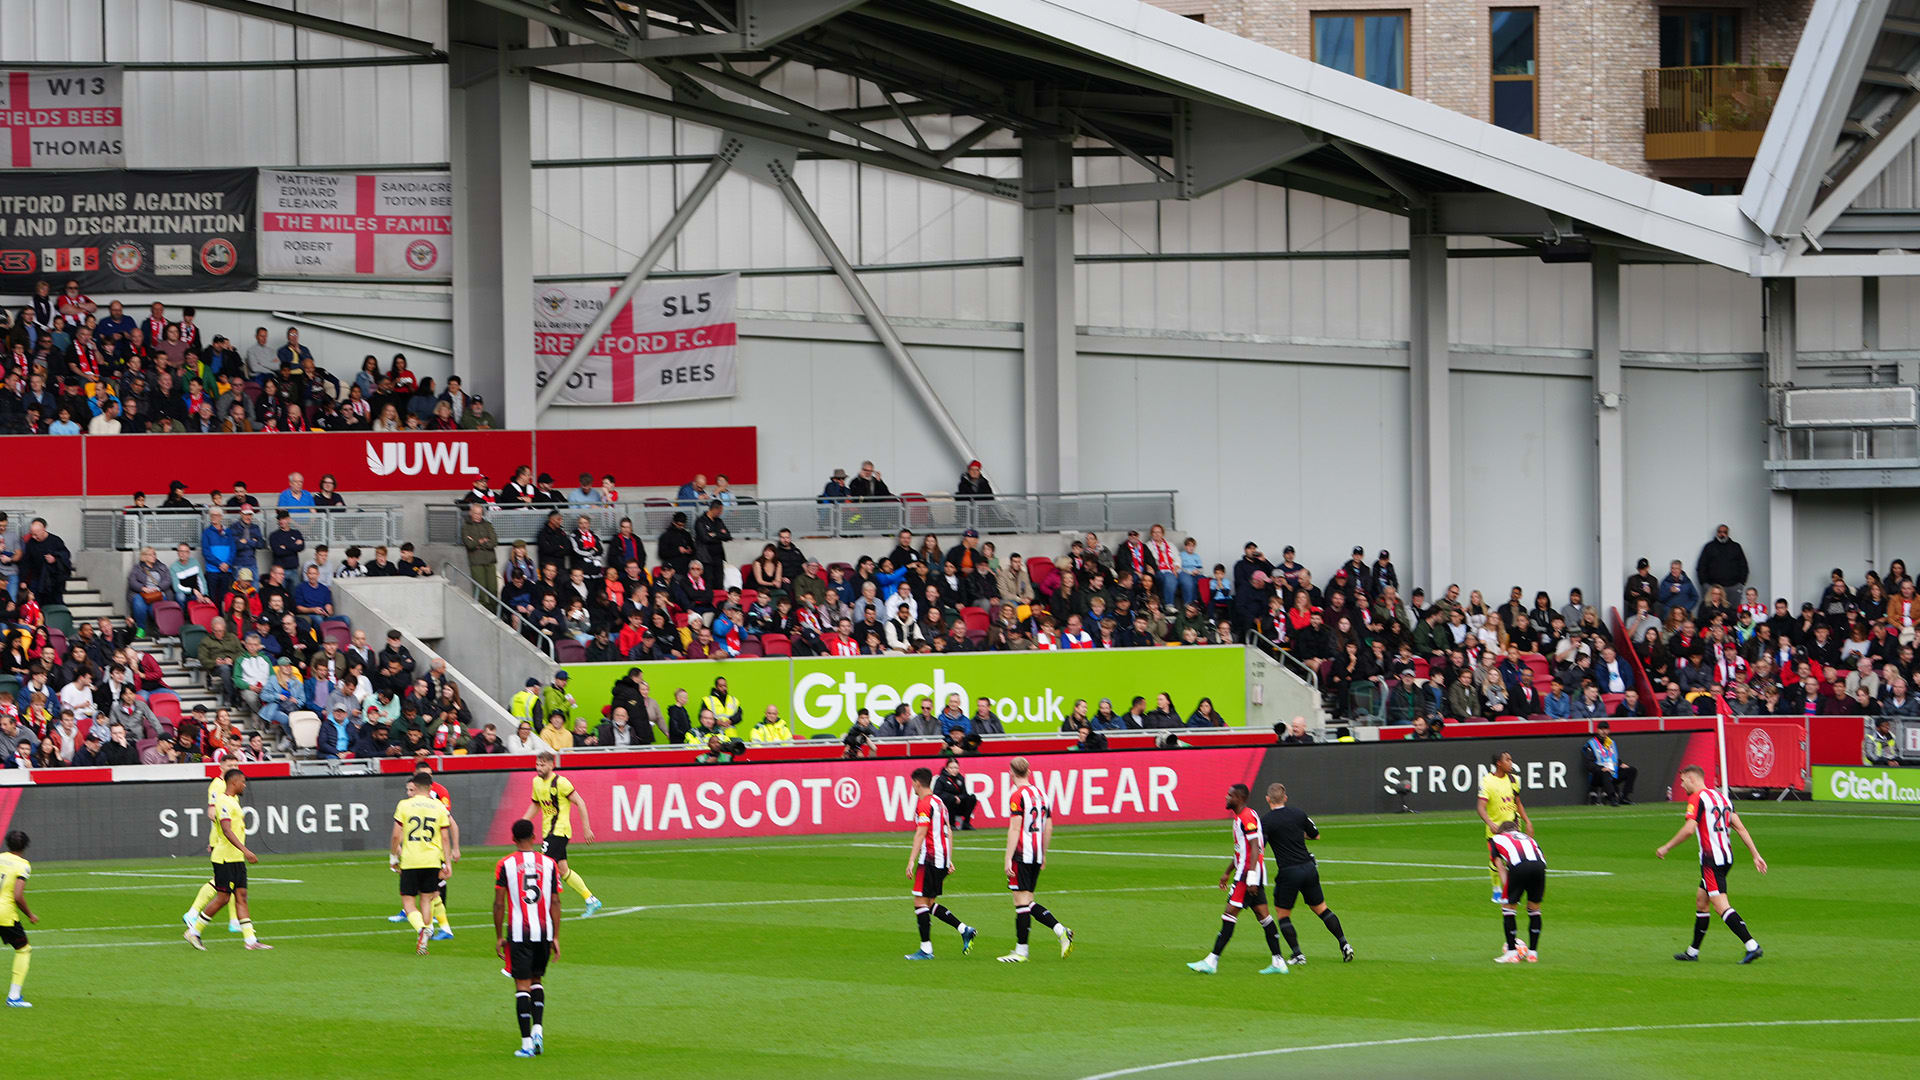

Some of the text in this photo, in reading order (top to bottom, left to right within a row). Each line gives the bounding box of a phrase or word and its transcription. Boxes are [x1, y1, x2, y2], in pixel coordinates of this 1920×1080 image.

[47, 77, 105, 96] W13
[67, 110, 115, 125] BEES
[33, 140, 122, 156] THOMAS
[276, 175, 339, 186] MATTHEW
[281, 187, 336, 197] EDWARD
[384, 196, 427, 207] TOTON
[0, 192, 225, 214] TFORD FANS AGAINST
[279, 199, 338, 209] ELEANOR
[14, 218, 58, 237] AND
[64, 214, 245, 236] DISCRIMINATION
[276, 215, 452, 232] THE MILES FAMILY
[283, 240, 333, 251] ROBERT
[44, 254, 96, 267] bias
[295, 255, 322, 265] LISA
[574, 300, 604, 310] 2020
[663, 292, 711, 317] SL5
[675, 329, 713, 349] F.C.
[536, 370, 597, 390] SOT
[661, 364, 715, 385] BEES
[793, 668, 1065, 730] Gtecho.uk
[876, 766, 1180, 822] WRWEAR
[159, 803, 370, 838] STONGER
[408, 816, 437, 842] 25
[1711, 806, 1732, 833] 20
[522, 874, 541, 905] 5
